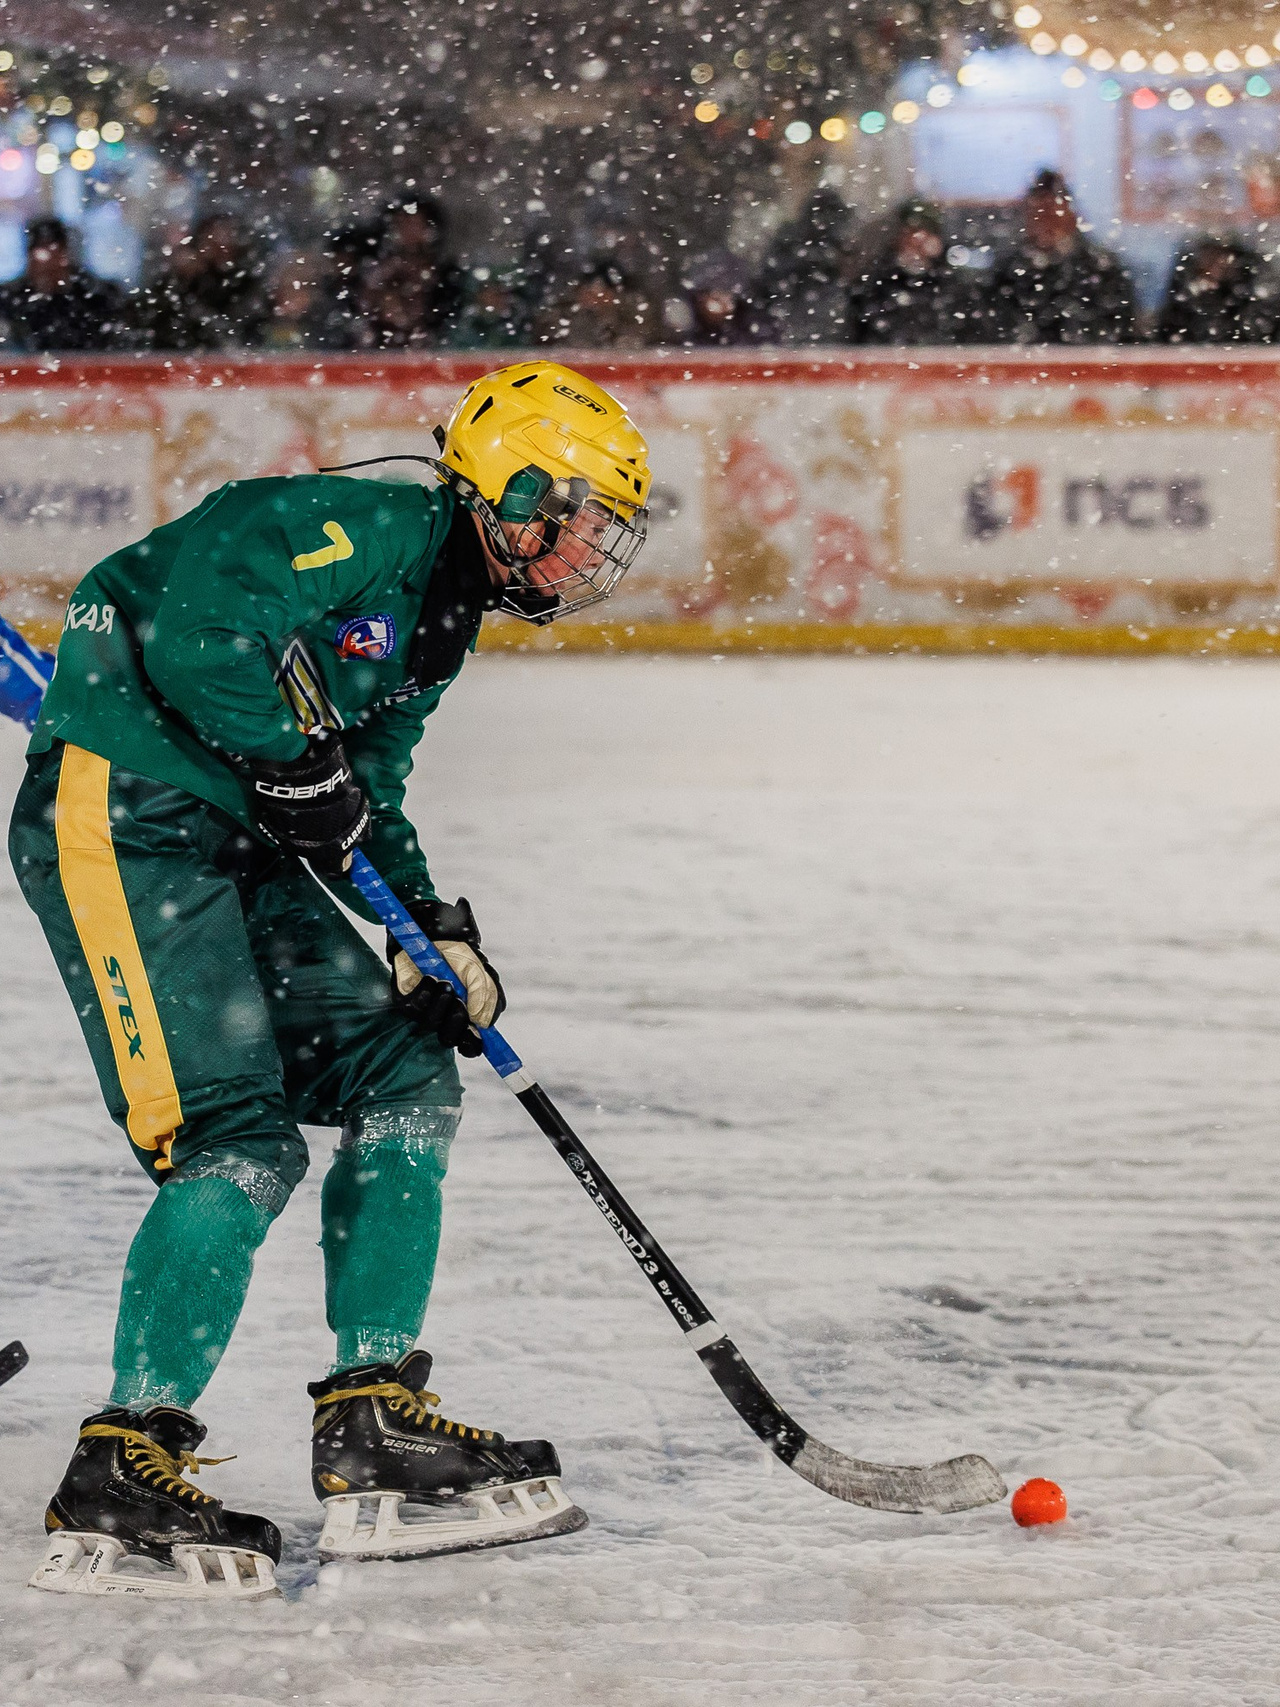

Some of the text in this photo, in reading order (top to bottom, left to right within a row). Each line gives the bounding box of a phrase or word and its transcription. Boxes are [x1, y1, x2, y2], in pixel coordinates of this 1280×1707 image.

[559, 384, 606, 414] CCM
[1062, 477, 1211, 530] ПСБ
[62, 602, 117, 635] КАЯ
[255, 767, 350, 799] COBRA
[341, 811, 369, 851] CARBON
[102, 955, 146, 1062] STEX
[381, 1438, 439, 1455] BAUER
